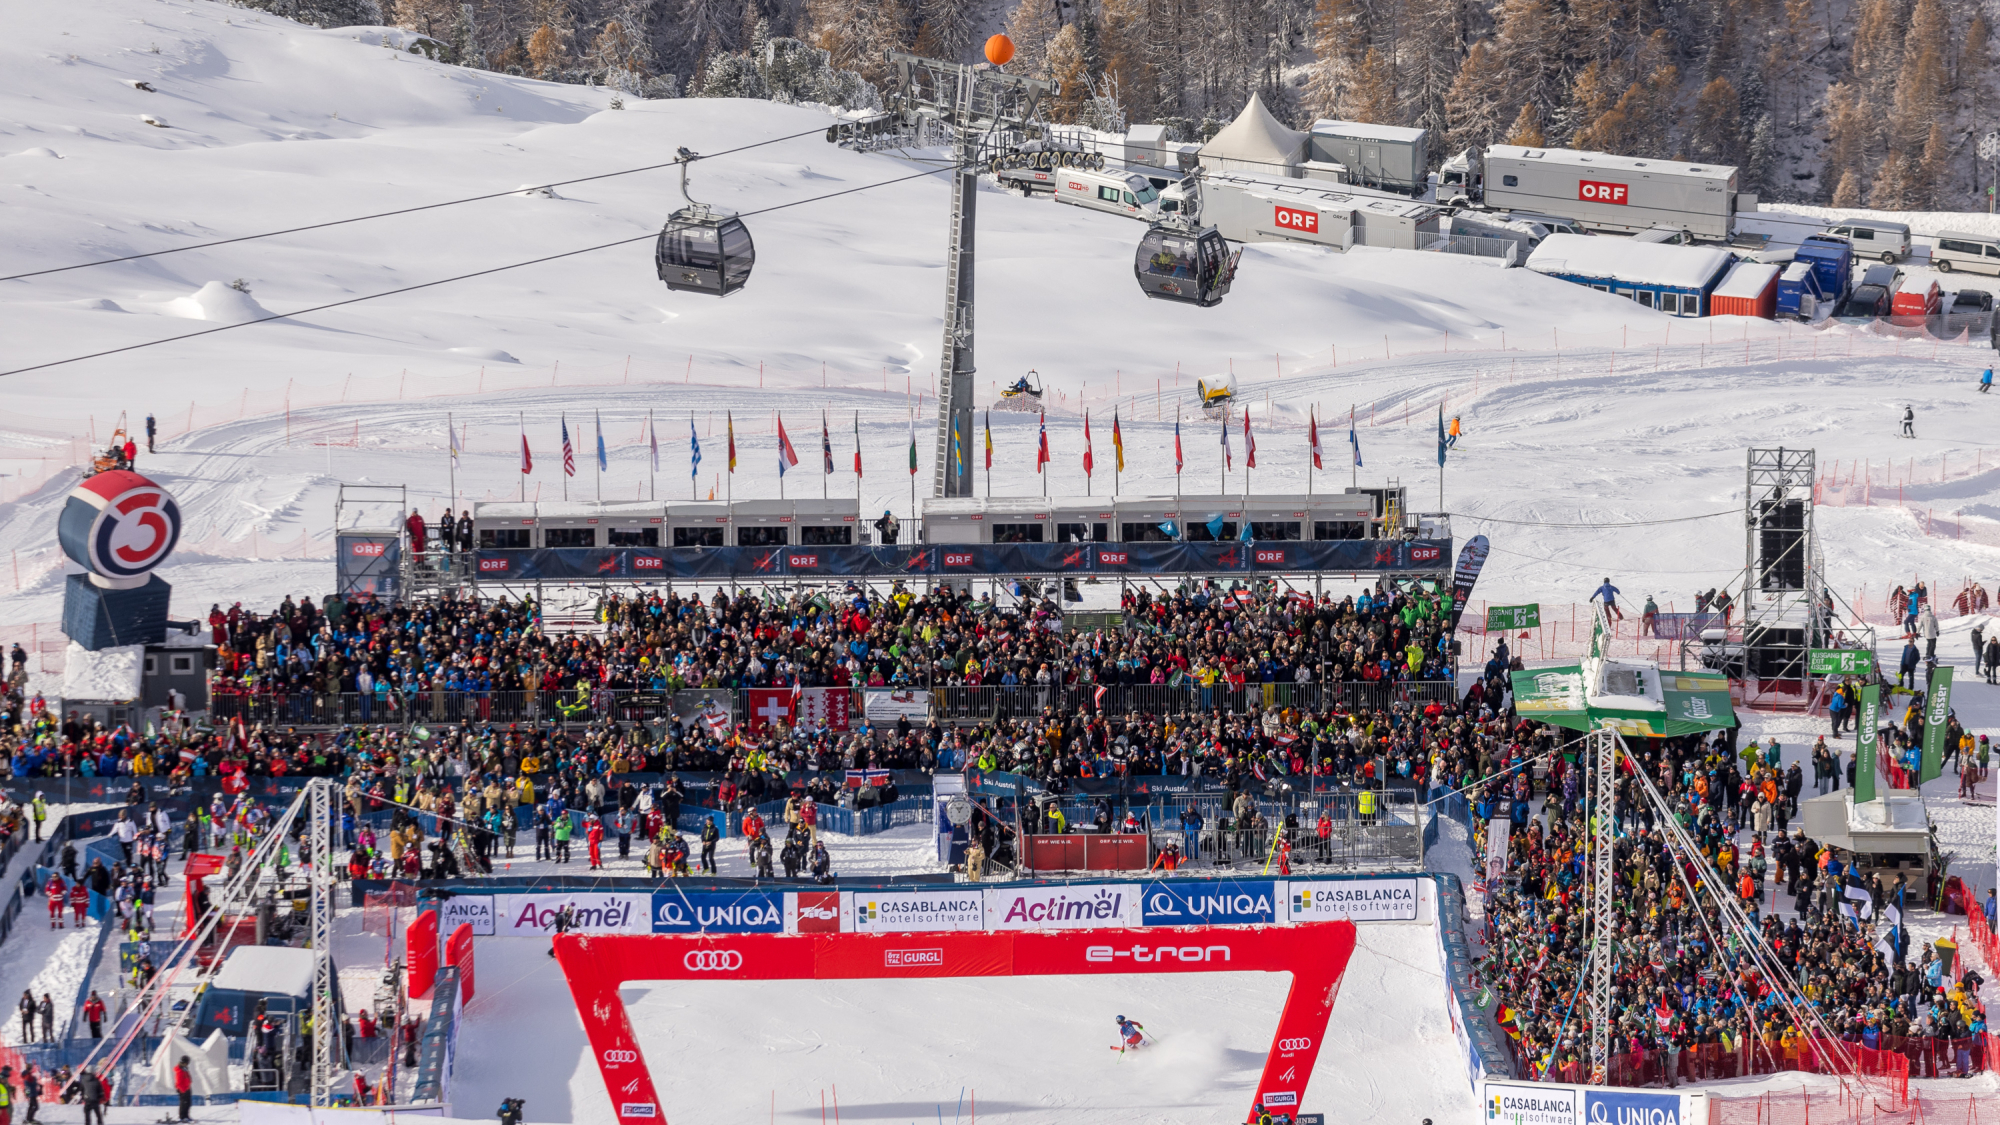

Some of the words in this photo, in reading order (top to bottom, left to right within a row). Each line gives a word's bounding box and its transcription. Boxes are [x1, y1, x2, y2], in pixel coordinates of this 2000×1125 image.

[1070, 182, 1082, 190] ORF
[1582, 184, 1625, 200] ORF
[1278, 210, 1316, 228] ORF
[355, 545, 382, 554] ORF
[1928, 684, 1947, 725] Gösser
[1860, 702, 1876, 744] Gösser
[984, 778, 993, 786] Ski
[994, 780, 1016, 790] Austria
[1315, 889, 1412, 902] CASABLANCA
[446, 904, 489, 916] ANCA
[881, 900, 978, 912] CASABLANCA
[1004, 888, 1122, 923] Actimel
[1188, 894, 1272, 916] UNIQA
[1315, 902, 1412, 912] hotelsoftware
[697, 904, 780, 926] UNIQA
[800, 906, 837, 920] Tirol
[881, 913, 979, 923] hotelsoftware
[904, 952, 940, 963] GURGL
[1086, 944, 1230, 962] e-tron
[1504, 1097, 1572, 1113] CASABLANCA
[1504, 1111, 1572, 1125] hotelsoftware
[1618, 1106, 1676, 1125] UNIQA
